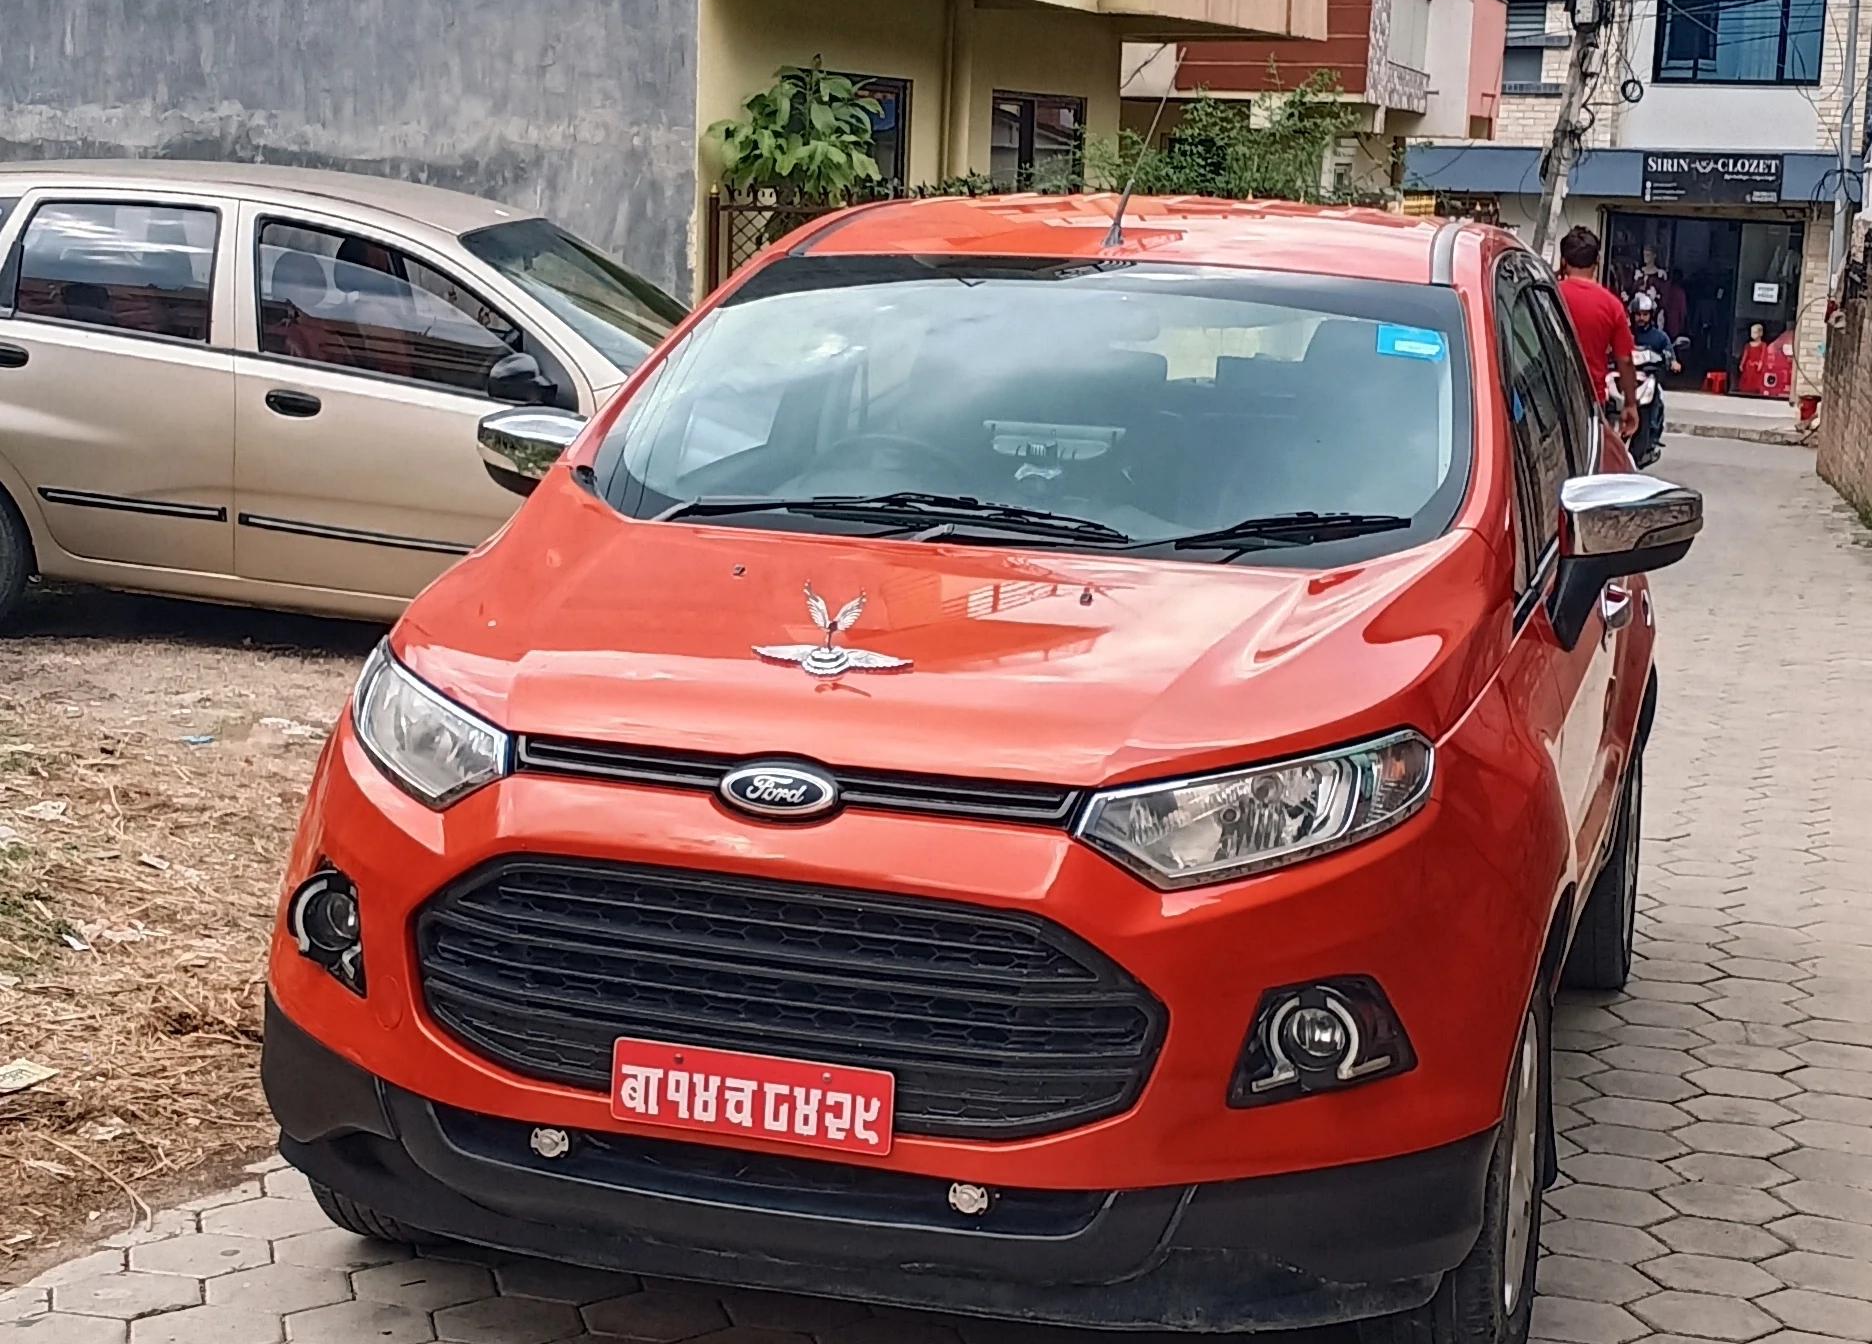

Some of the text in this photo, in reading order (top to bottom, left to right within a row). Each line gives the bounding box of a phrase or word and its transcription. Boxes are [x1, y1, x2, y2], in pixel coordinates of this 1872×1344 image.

[1647, 157, 1689, 172] SIRIN
[1717, 158, 1779, 173] CLOZET
[745, 775, 807, 804] Ford
